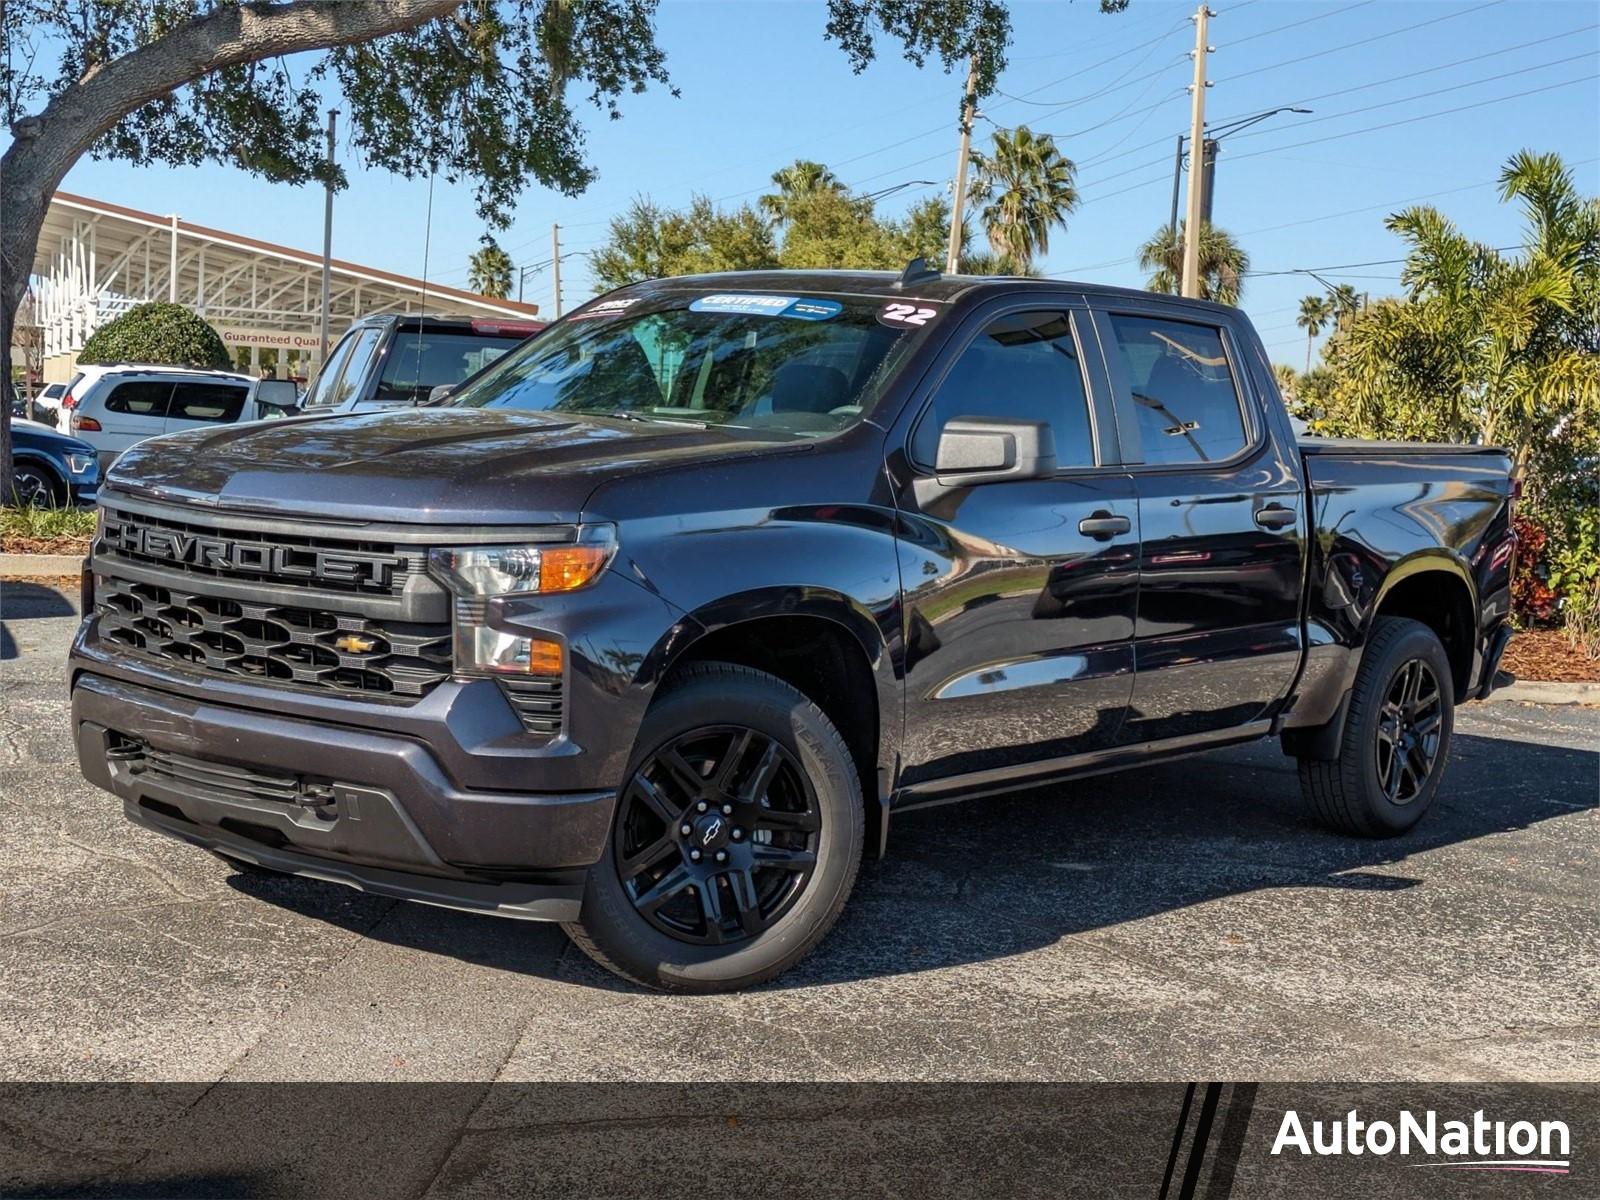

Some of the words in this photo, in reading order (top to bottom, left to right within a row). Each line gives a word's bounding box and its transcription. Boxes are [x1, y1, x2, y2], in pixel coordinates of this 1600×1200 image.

[701, 295, 789, 307] CERTIFIED
[224, 332, 290, 345] Guaranteed
[294, 336, 335, 348] Qualy
[103, 522, 408, 586] CHEVROLET
